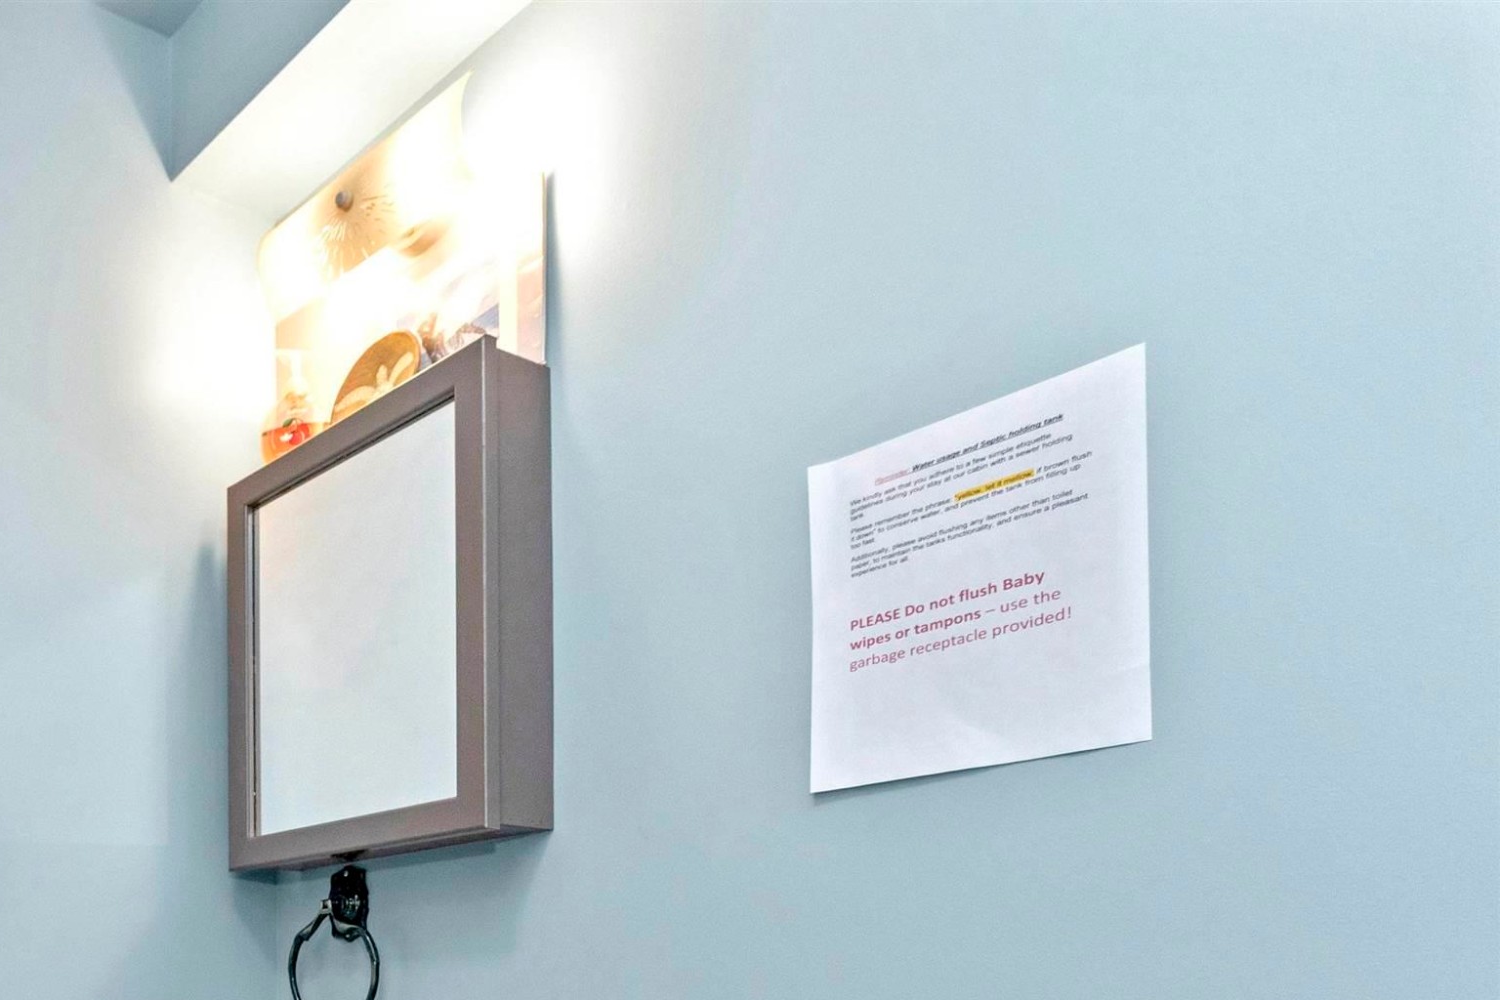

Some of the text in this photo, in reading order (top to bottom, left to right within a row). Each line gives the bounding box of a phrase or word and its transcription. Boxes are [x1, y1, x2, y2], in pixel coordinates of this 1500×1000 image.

[885, 491, 907, 502] during
[910, 485, 924, 495] your
[927, 480, 941, 488] stay
[953, 471, 964, 479] our
[967, 464, 988, 474] cabin
[990, 457, 1005, 466] with
[1042, 434, 1072, 449] holding
[912, 460, 934, 471] Water
[962, 443, 978, 454] and
[979, 435, 1005, 448] Septic
[1008, 422, 1041, 438] holding
[1044, 414, 1063, 426] tank
[914, 477, 926, 486] you
[988, 447, 1013, 459] simple
[1016, 434, 1051, 449] etiquette
[1044, 459, 1069, 472] brown
[1071, 451, 1092, 462] flush
[886, 517, 918, 530] conserve
[944, 503, 959, 512] and
[960, 493, 989, 508] prevent
[1005, 483, 1022, 492] tank
[1025, 476, 1044, 485] from
[1045, 468, 1068, 479] filling
[918, 531, 937, 542] avoid
[939, 523, 968, 535] flushing
[986, 511, 1007, 520] items
[1009, 503, 1030, 514] other
[1032, 497, 1050, 506] than
[1052, 489, 1072, 500] toilet
[997, 516, 1012, 526] and
[1013, 508, 1042, 520] ensure
[1052, 493, 1088, 510] pleasant
[850, 633, 891, 650] wipes
[895, 628, 910, 639] or
[914, 610, 981, 634] tampons
[1000, 599, 1028, 612] use
[1033, 591, 1060, 604] the
[851, 572, 1044, 631] PLEASE Do not flush Baby
[850, 606, 1071, 672] garbage receptacle provided!
